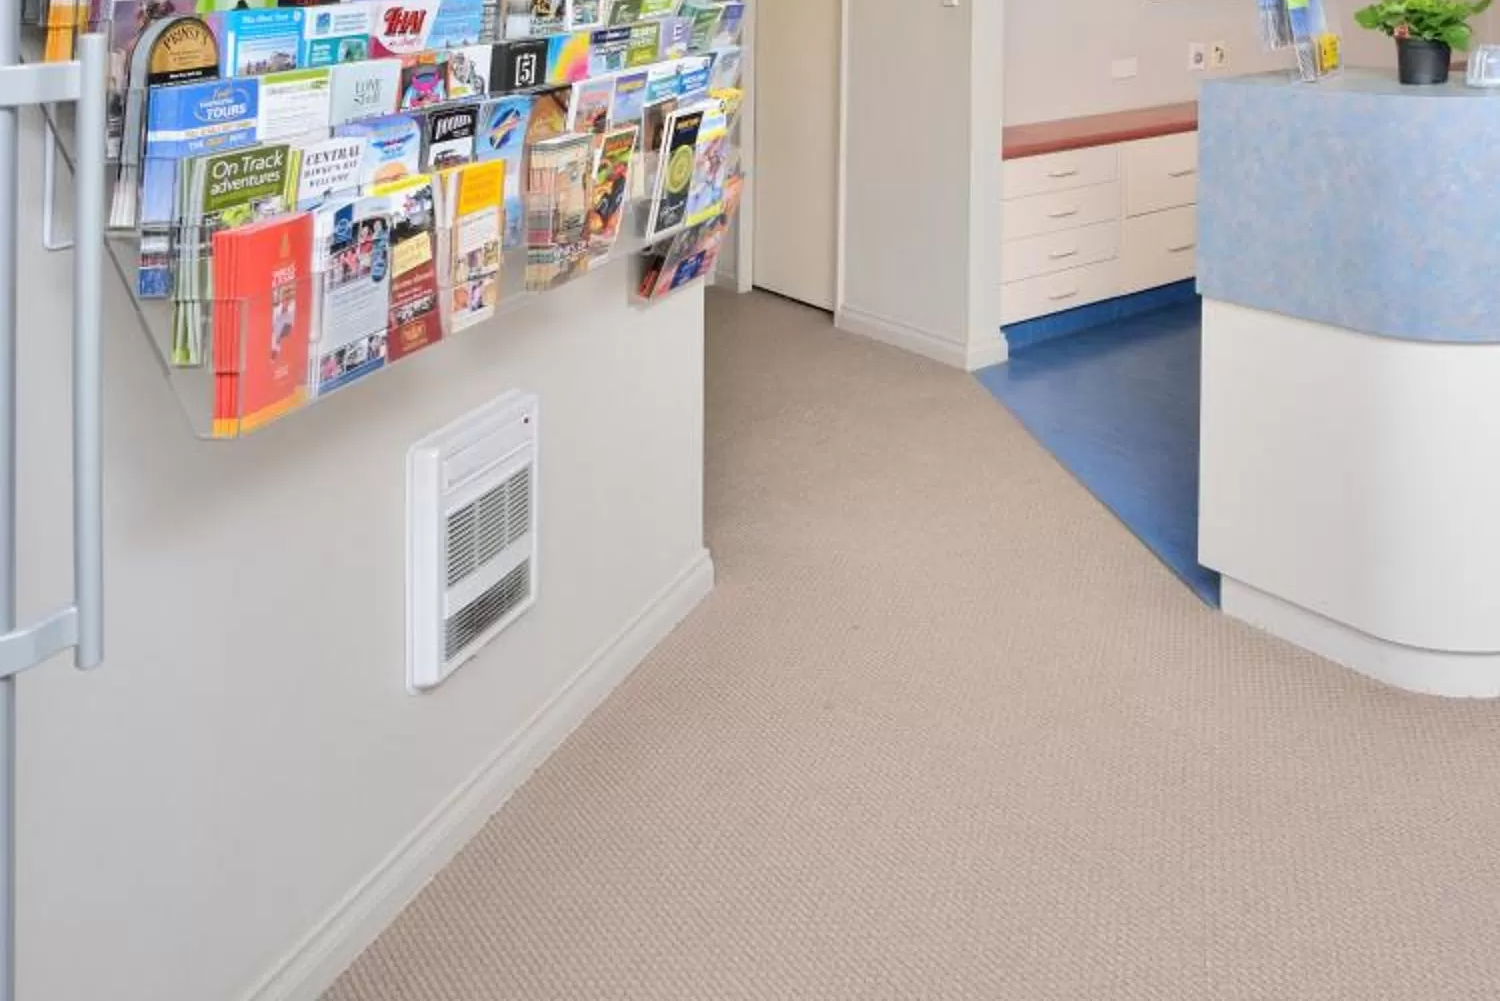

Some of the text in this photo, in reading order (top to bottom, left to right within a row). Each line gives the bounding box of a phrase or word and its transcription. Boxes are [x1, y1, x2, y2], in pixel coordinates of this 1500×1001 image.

[206, 102, 247, 120] TOURS
[212, 150, 283, 180] On Track
[305, 145, 360, 167] CENTRAL
[211, 170, 281, 197] adventures
